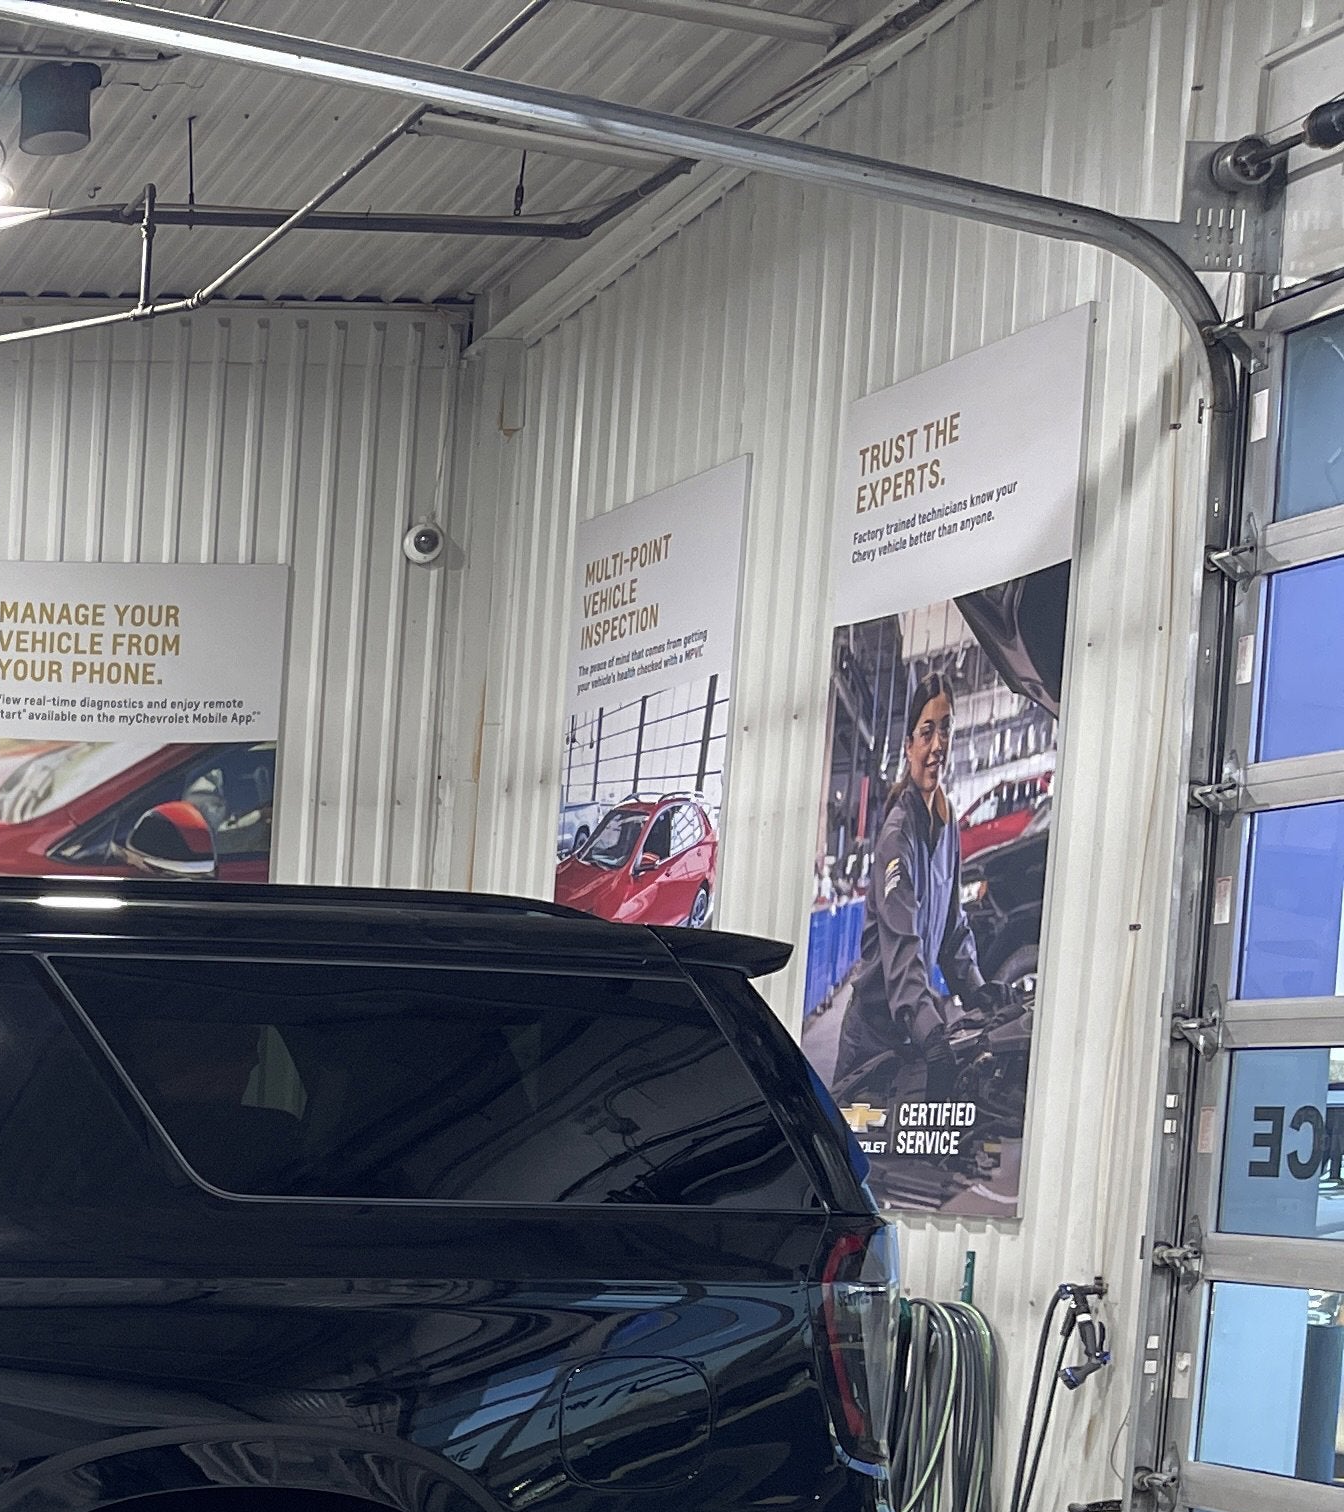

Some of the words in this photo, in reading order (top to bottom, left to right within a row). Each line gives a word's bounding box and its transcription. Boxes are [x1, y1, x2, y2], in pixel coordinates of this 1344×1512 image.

[859, 428, 918, 477] TRUST
[923, 412, 960, 453] THE
[856, 458, 945, 514] EXPERTS.
[853, 527, 884, 545] Factory
[886, 514, 916, 536] trained
[918, 499, 967, 526] technicians
[969, 489, 994, 508] know
[996, 481, 1018, 502] your
[852, 548, 876, 563] Chevy
[878, 537, 907, 557] vehicle
[909, 530, 937, 548] better
[938, 522, 958, 538] than
[960, 510, 995, 531] anyone.
[584, 533, 672, 588] MULTI-POINT
[0, 601, 106, 627] MANAGE
[114, 604, 180, 628] YOUR
[583, 578, 638, 619] VEHICLE
[112, 633, 180, 656] FROM
[580, 603, 659, 650] INSPECTION
[71, 662, 163, 685] PHONE.
[578, 665, 589, 677] The
[616, 651, 630, 665] mind
[631, 648, 644, 661] that
[645, 643, 665, 657] comes
[666, 638, 682, 650] from
[683, 629, 708, 648] getting
[24, 696, 77, 708] real-time
[80, 697, 144, 711] diagnostics
[147, 698, 167, 709] and
[170, 698, 200, 712] enjoy
[203, 698, 244, 709] remote
[28, 710, 77, 722] available
[80, 713, 93, 722] on
[97, 712, 115, 723] the
[119, 712, 189, 726] myChevrolet
[192, 712, 228, 724] Mobile
[899, 1103, 976, 1126] CERTIFIED
[896, 1131, 960, 1154] SERVICE
